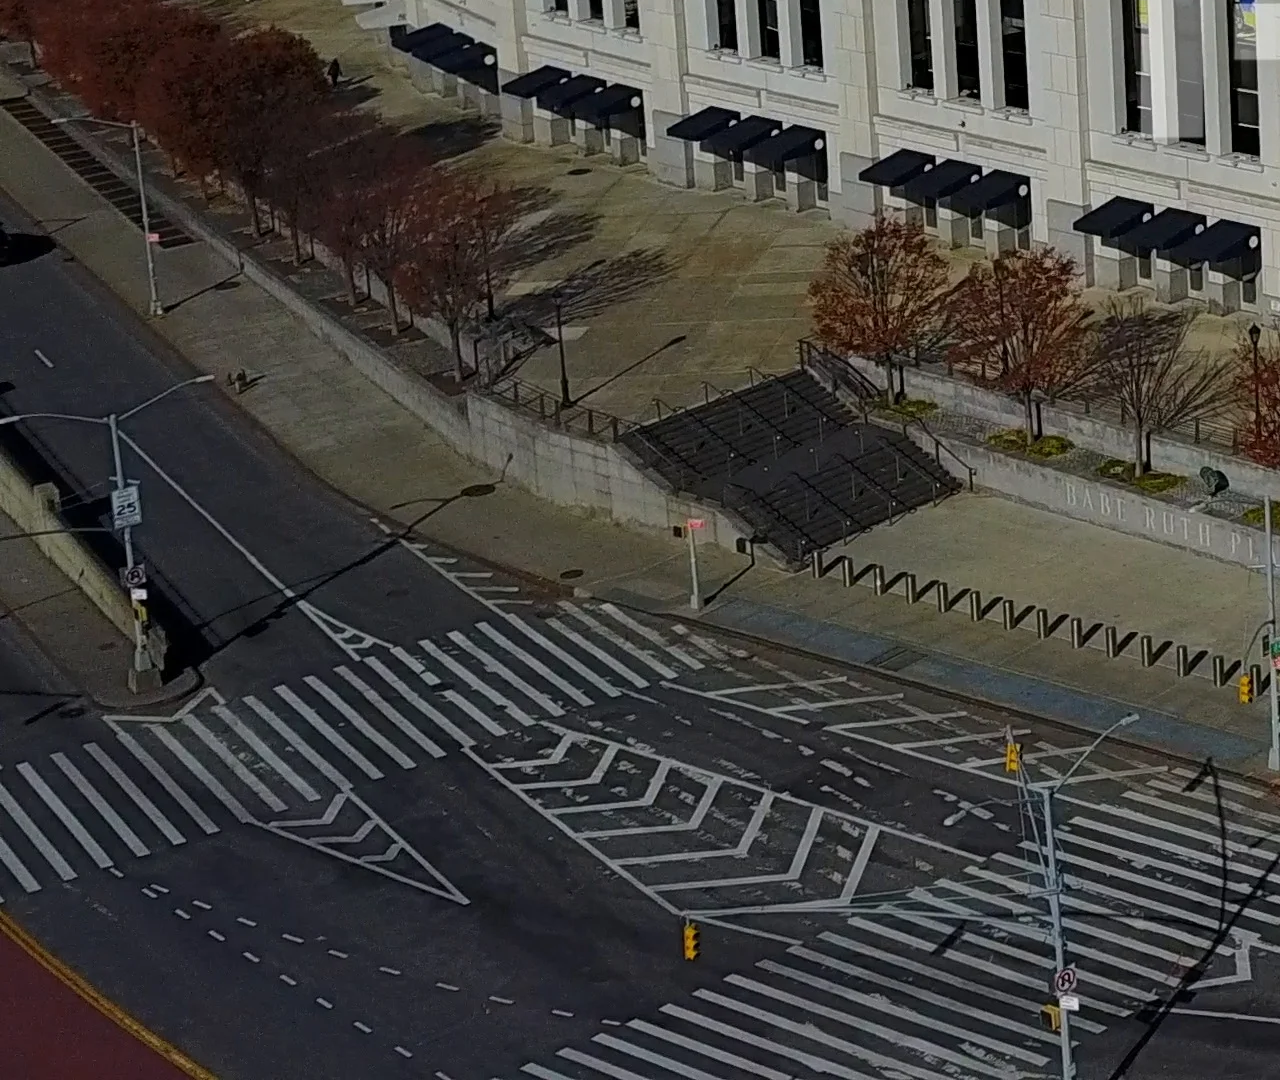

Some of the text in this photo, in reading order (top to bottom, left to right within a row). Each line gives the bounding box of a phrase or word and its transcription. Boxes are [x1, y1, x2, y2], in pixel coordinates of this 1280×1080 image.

[117, 502, 137, 516] 25
[1065, 482, 1127, 522] BABE
[1145, 508, 1212, 548] RUTH
